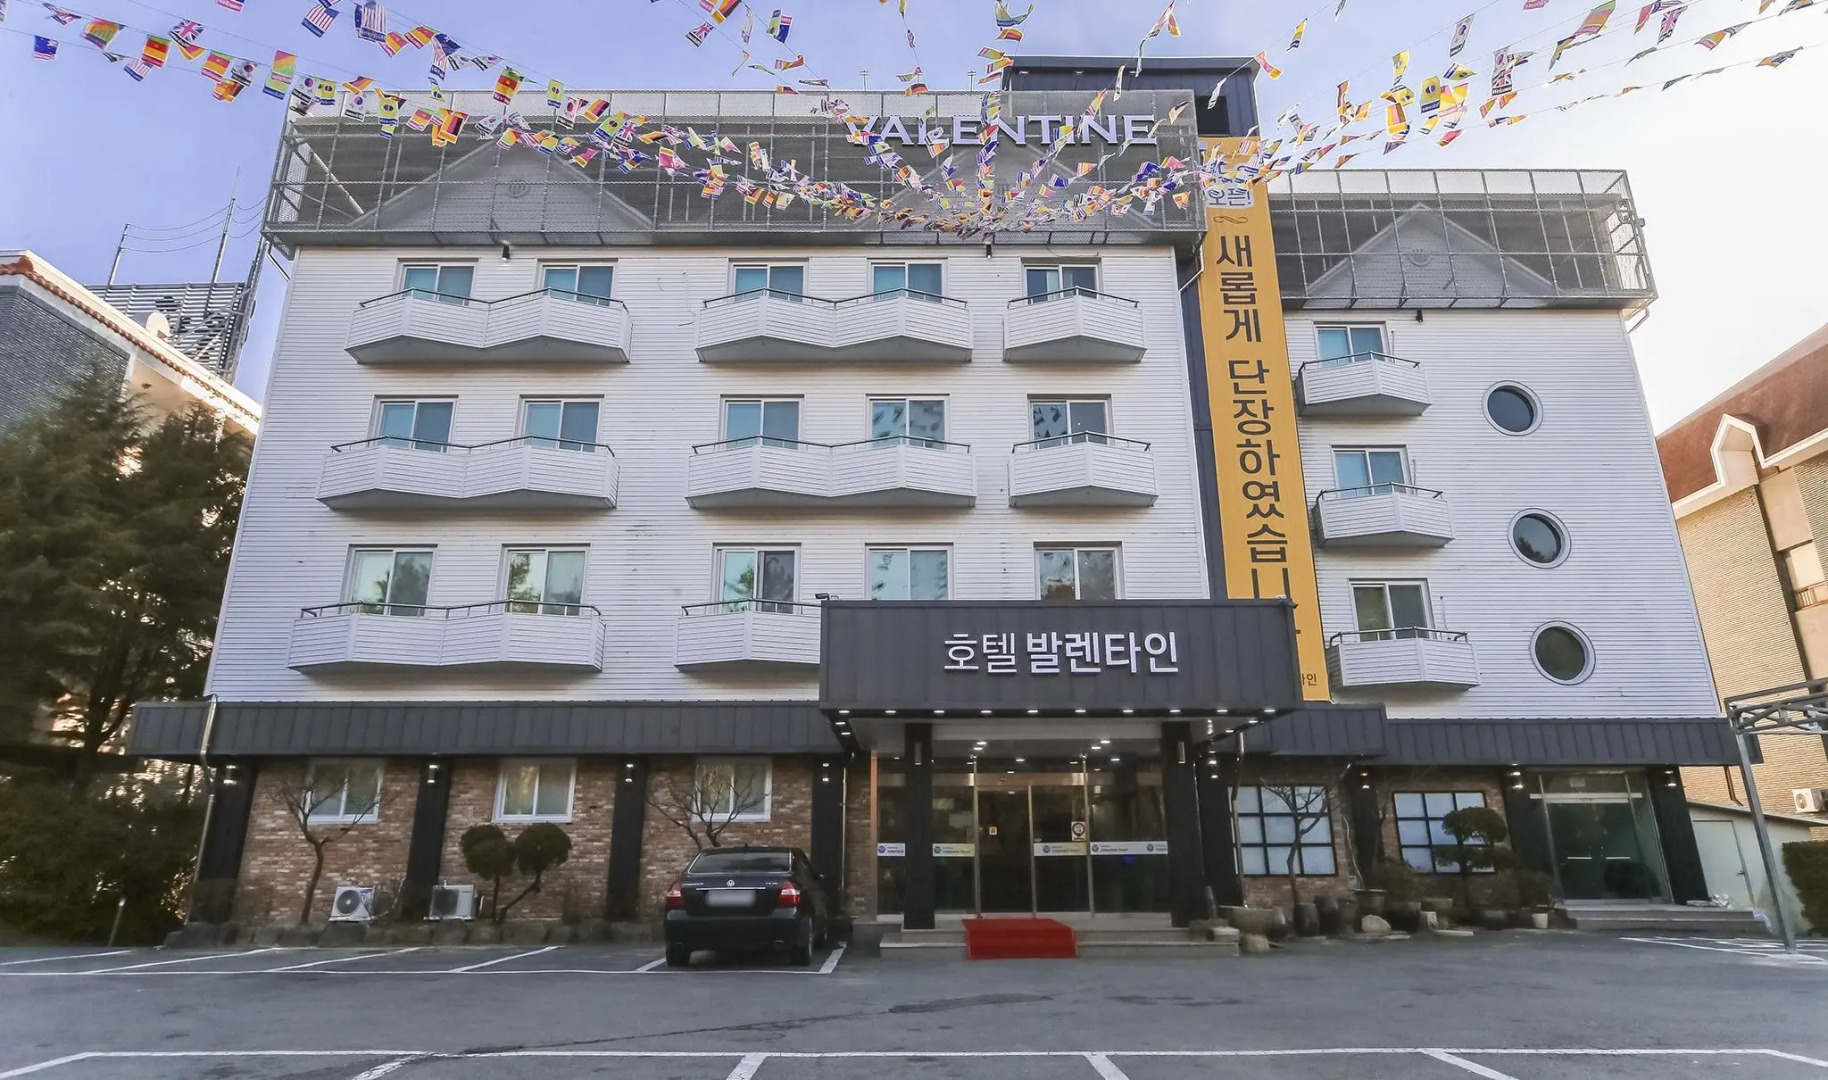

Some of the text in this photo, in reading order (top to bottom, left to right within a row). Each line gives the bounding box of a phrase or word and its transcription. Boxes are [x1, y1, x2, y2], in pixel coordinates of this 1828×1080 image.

[1216, 235, 1262, 343] 새롭게
[1228, 359, 1292, 600] 단장하였습니
[944, 631, 1179, 674] 호텔 발렌타인
